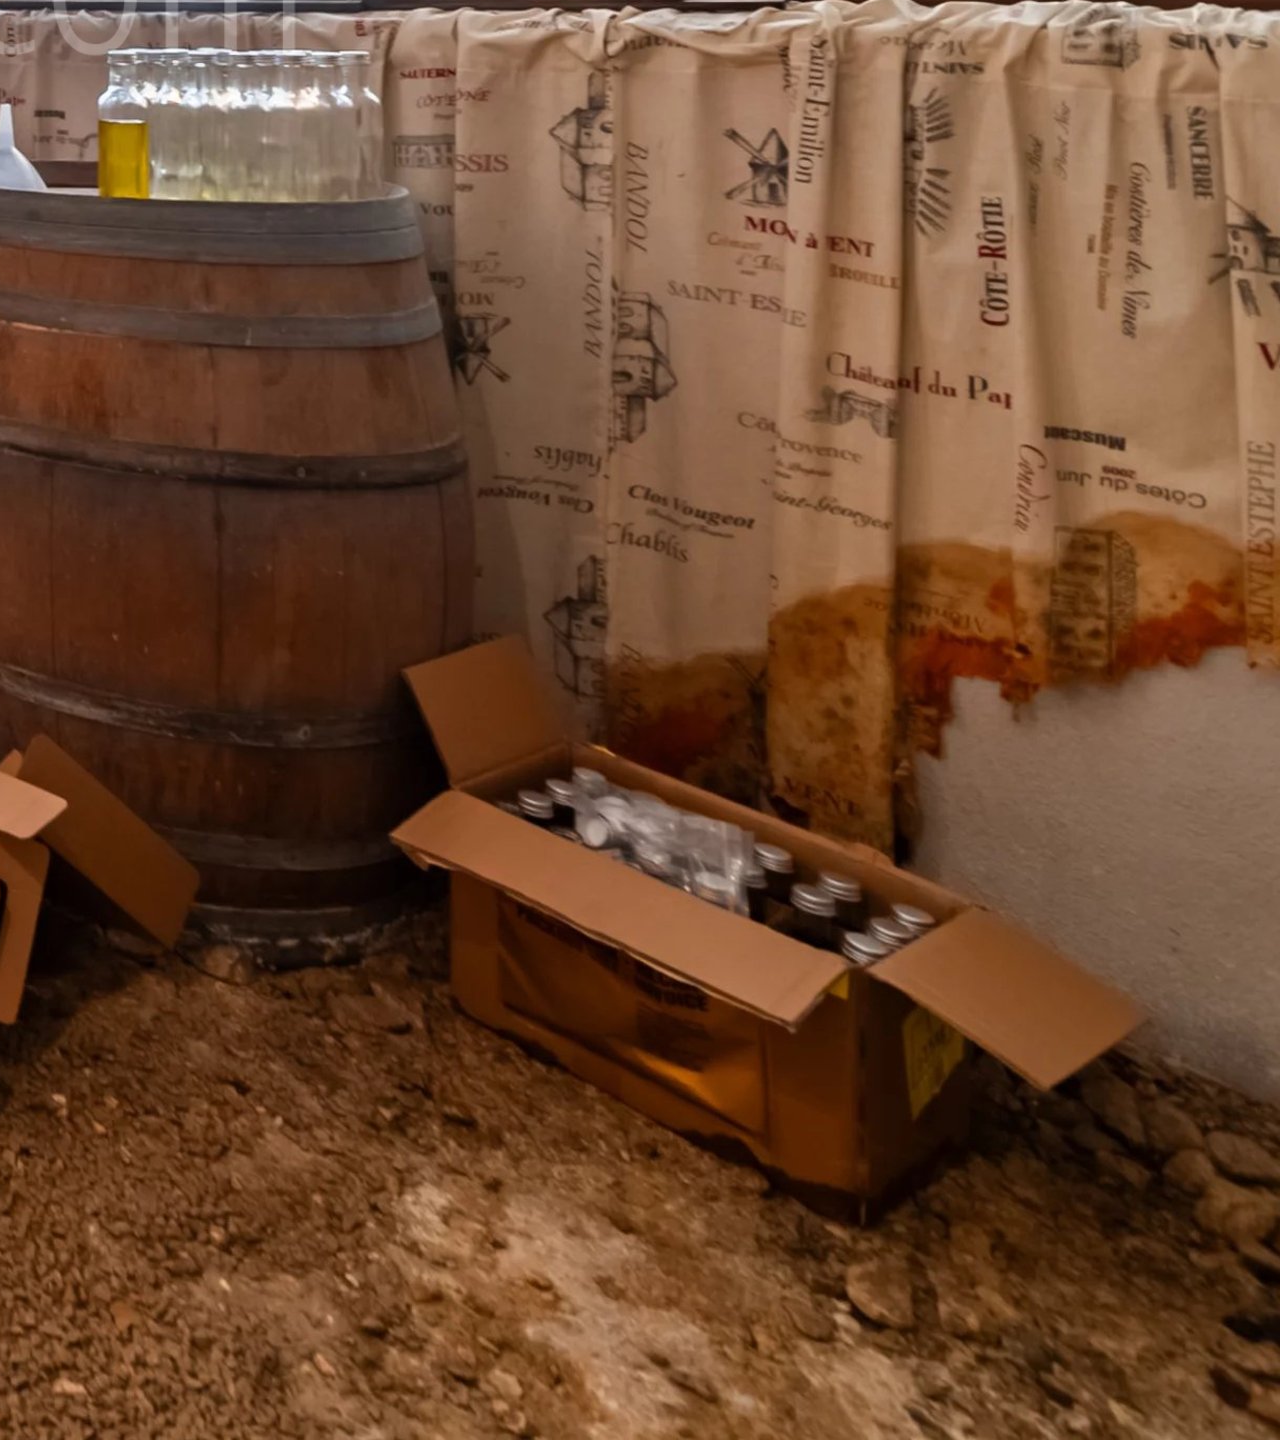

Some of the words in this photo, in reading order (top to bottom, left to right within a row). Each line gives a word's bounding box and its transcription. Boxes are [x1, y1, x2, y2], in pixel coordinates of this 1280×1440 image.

[1187, 105, 1215, 201] SANCERRE
[625, 141, 649, 253] BANDOL
[927, 371, 958, 398] du
[533, 444, 610, 478] hablis
[1099, 475, 1129, 494] du
[1135, 482, 1207, 509] Côtes
[628, 484, 669, 511] Clos
[672, 497, 756, 531] Vougeot
